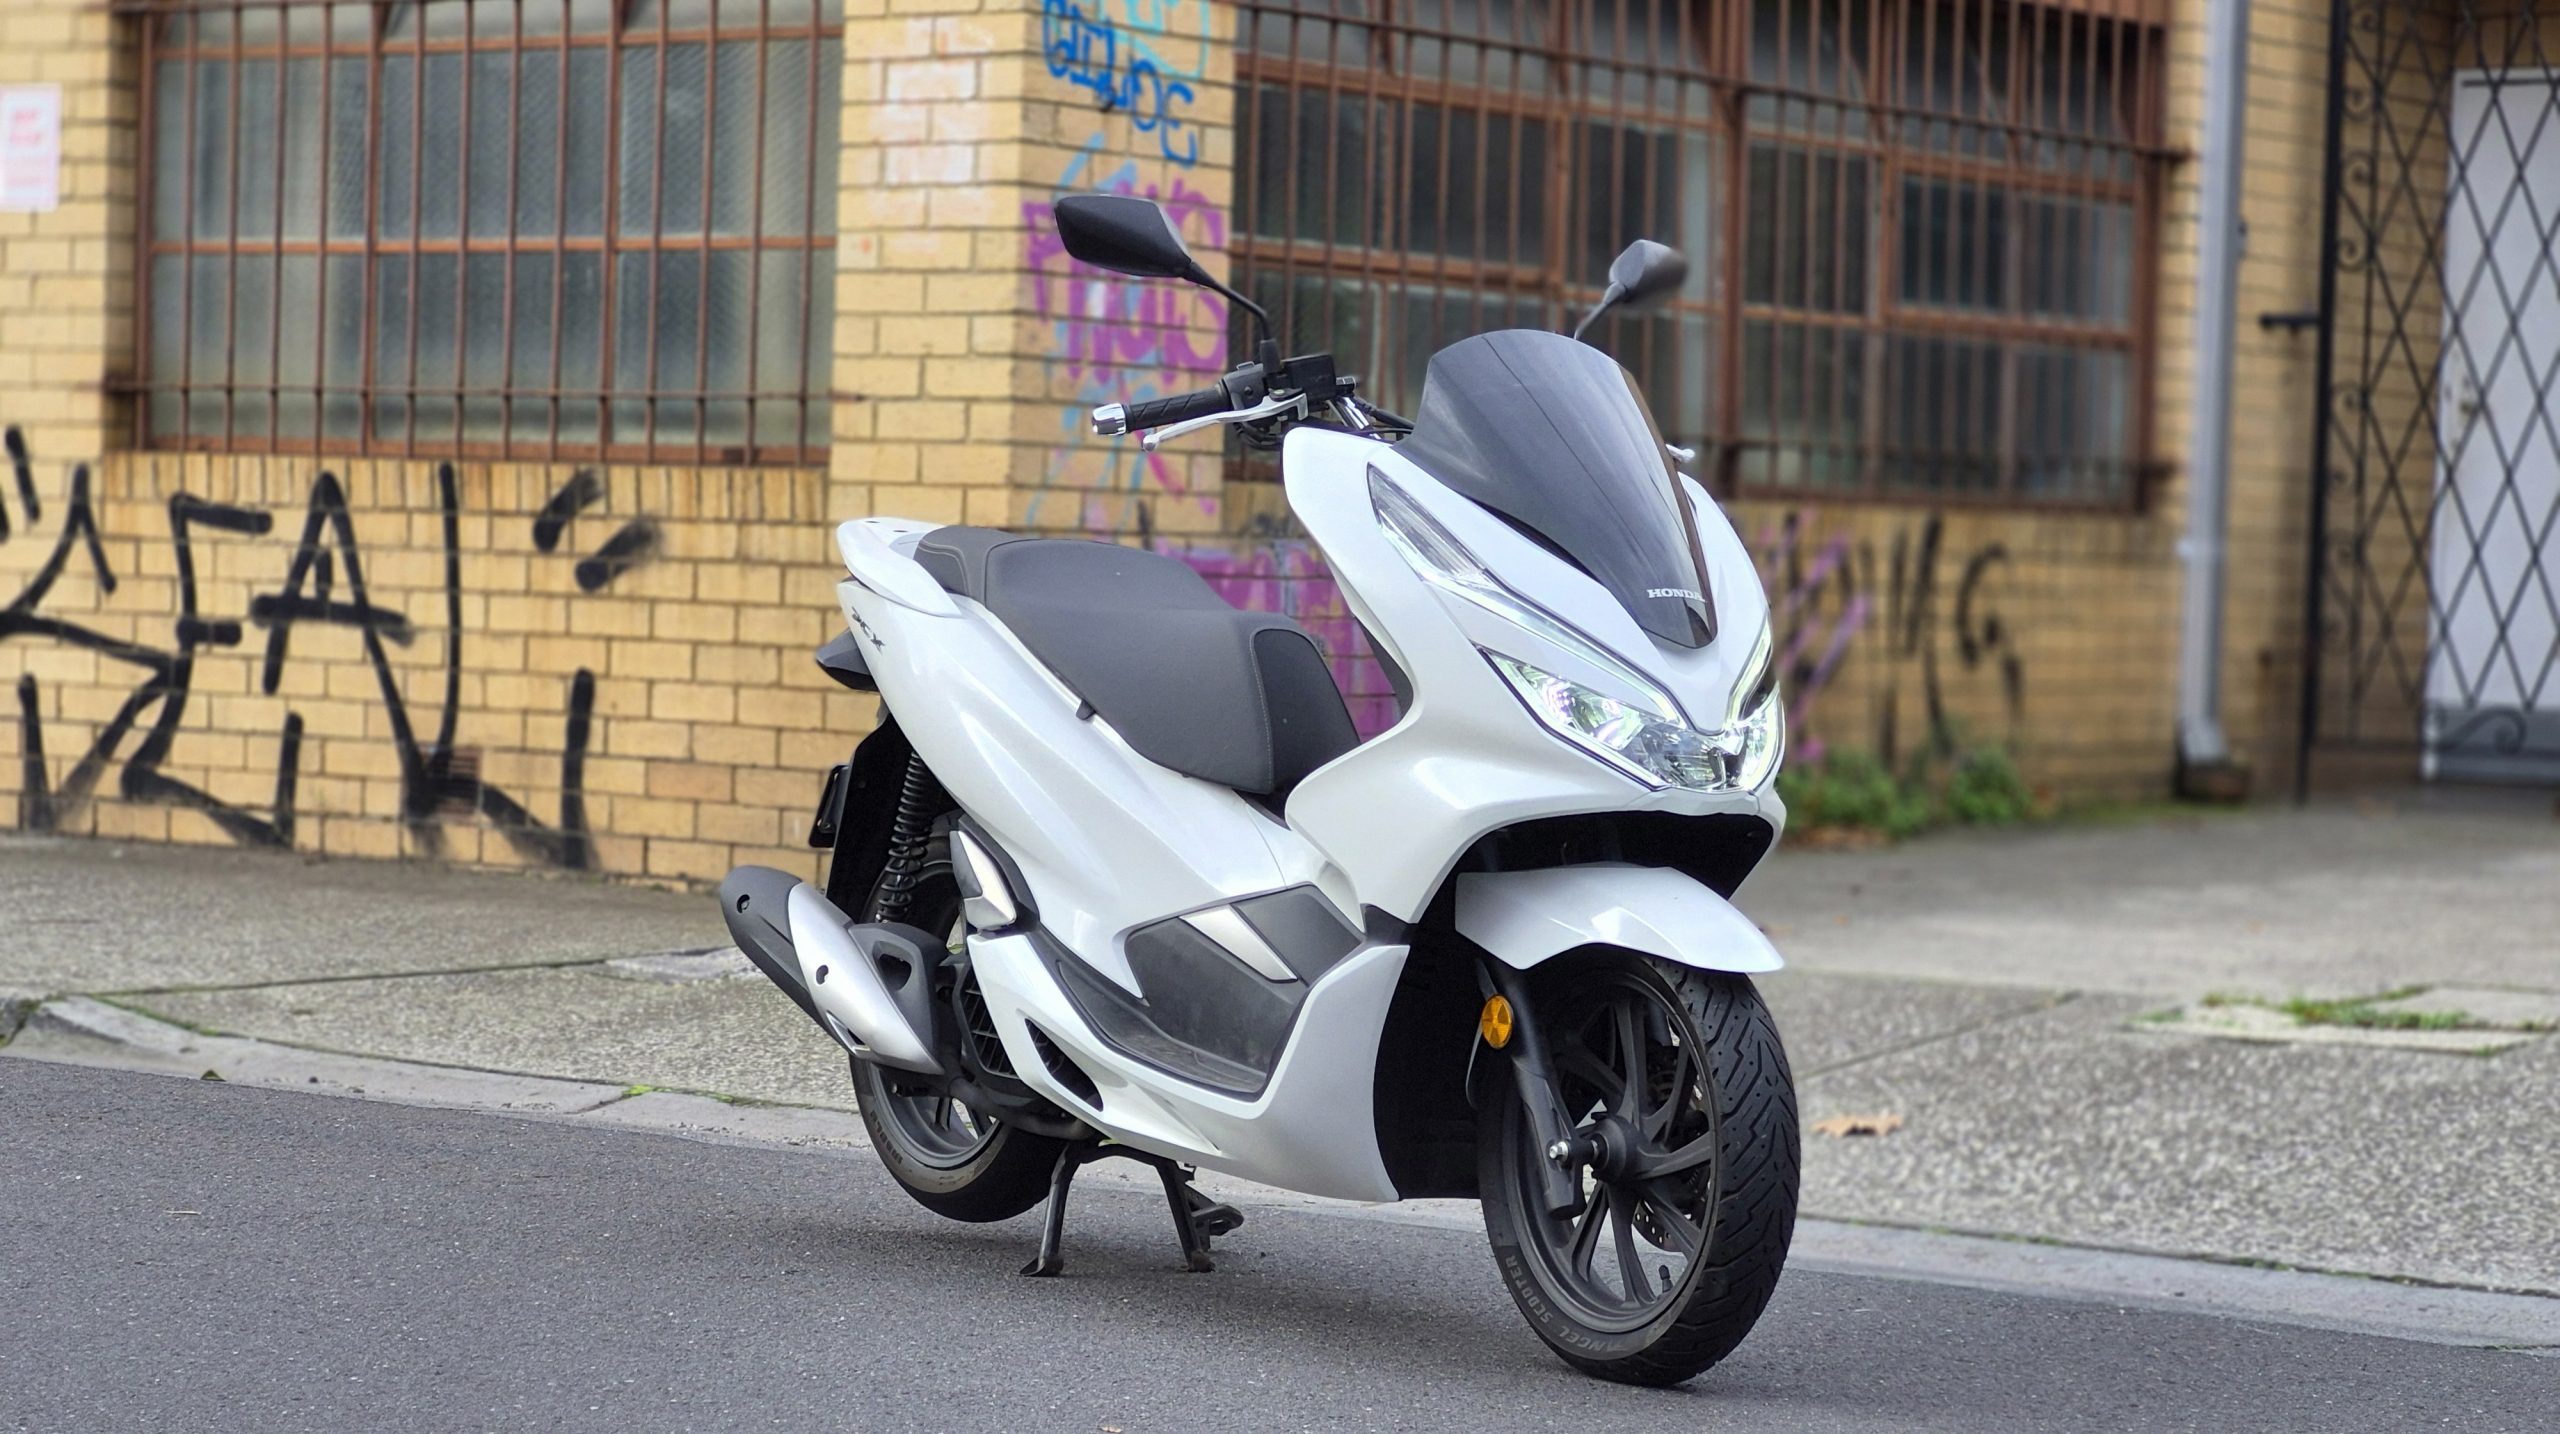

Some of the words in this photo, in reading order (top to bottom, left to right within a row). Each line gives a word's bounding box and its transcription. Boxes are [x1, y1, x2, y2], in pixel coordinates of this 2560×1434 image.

[1647, 588, 1705, 602] HONDA
[1505, 1255, 1553, 1324] SCOOTER
[1559, 1326, 1623, 1352] ANGEL
